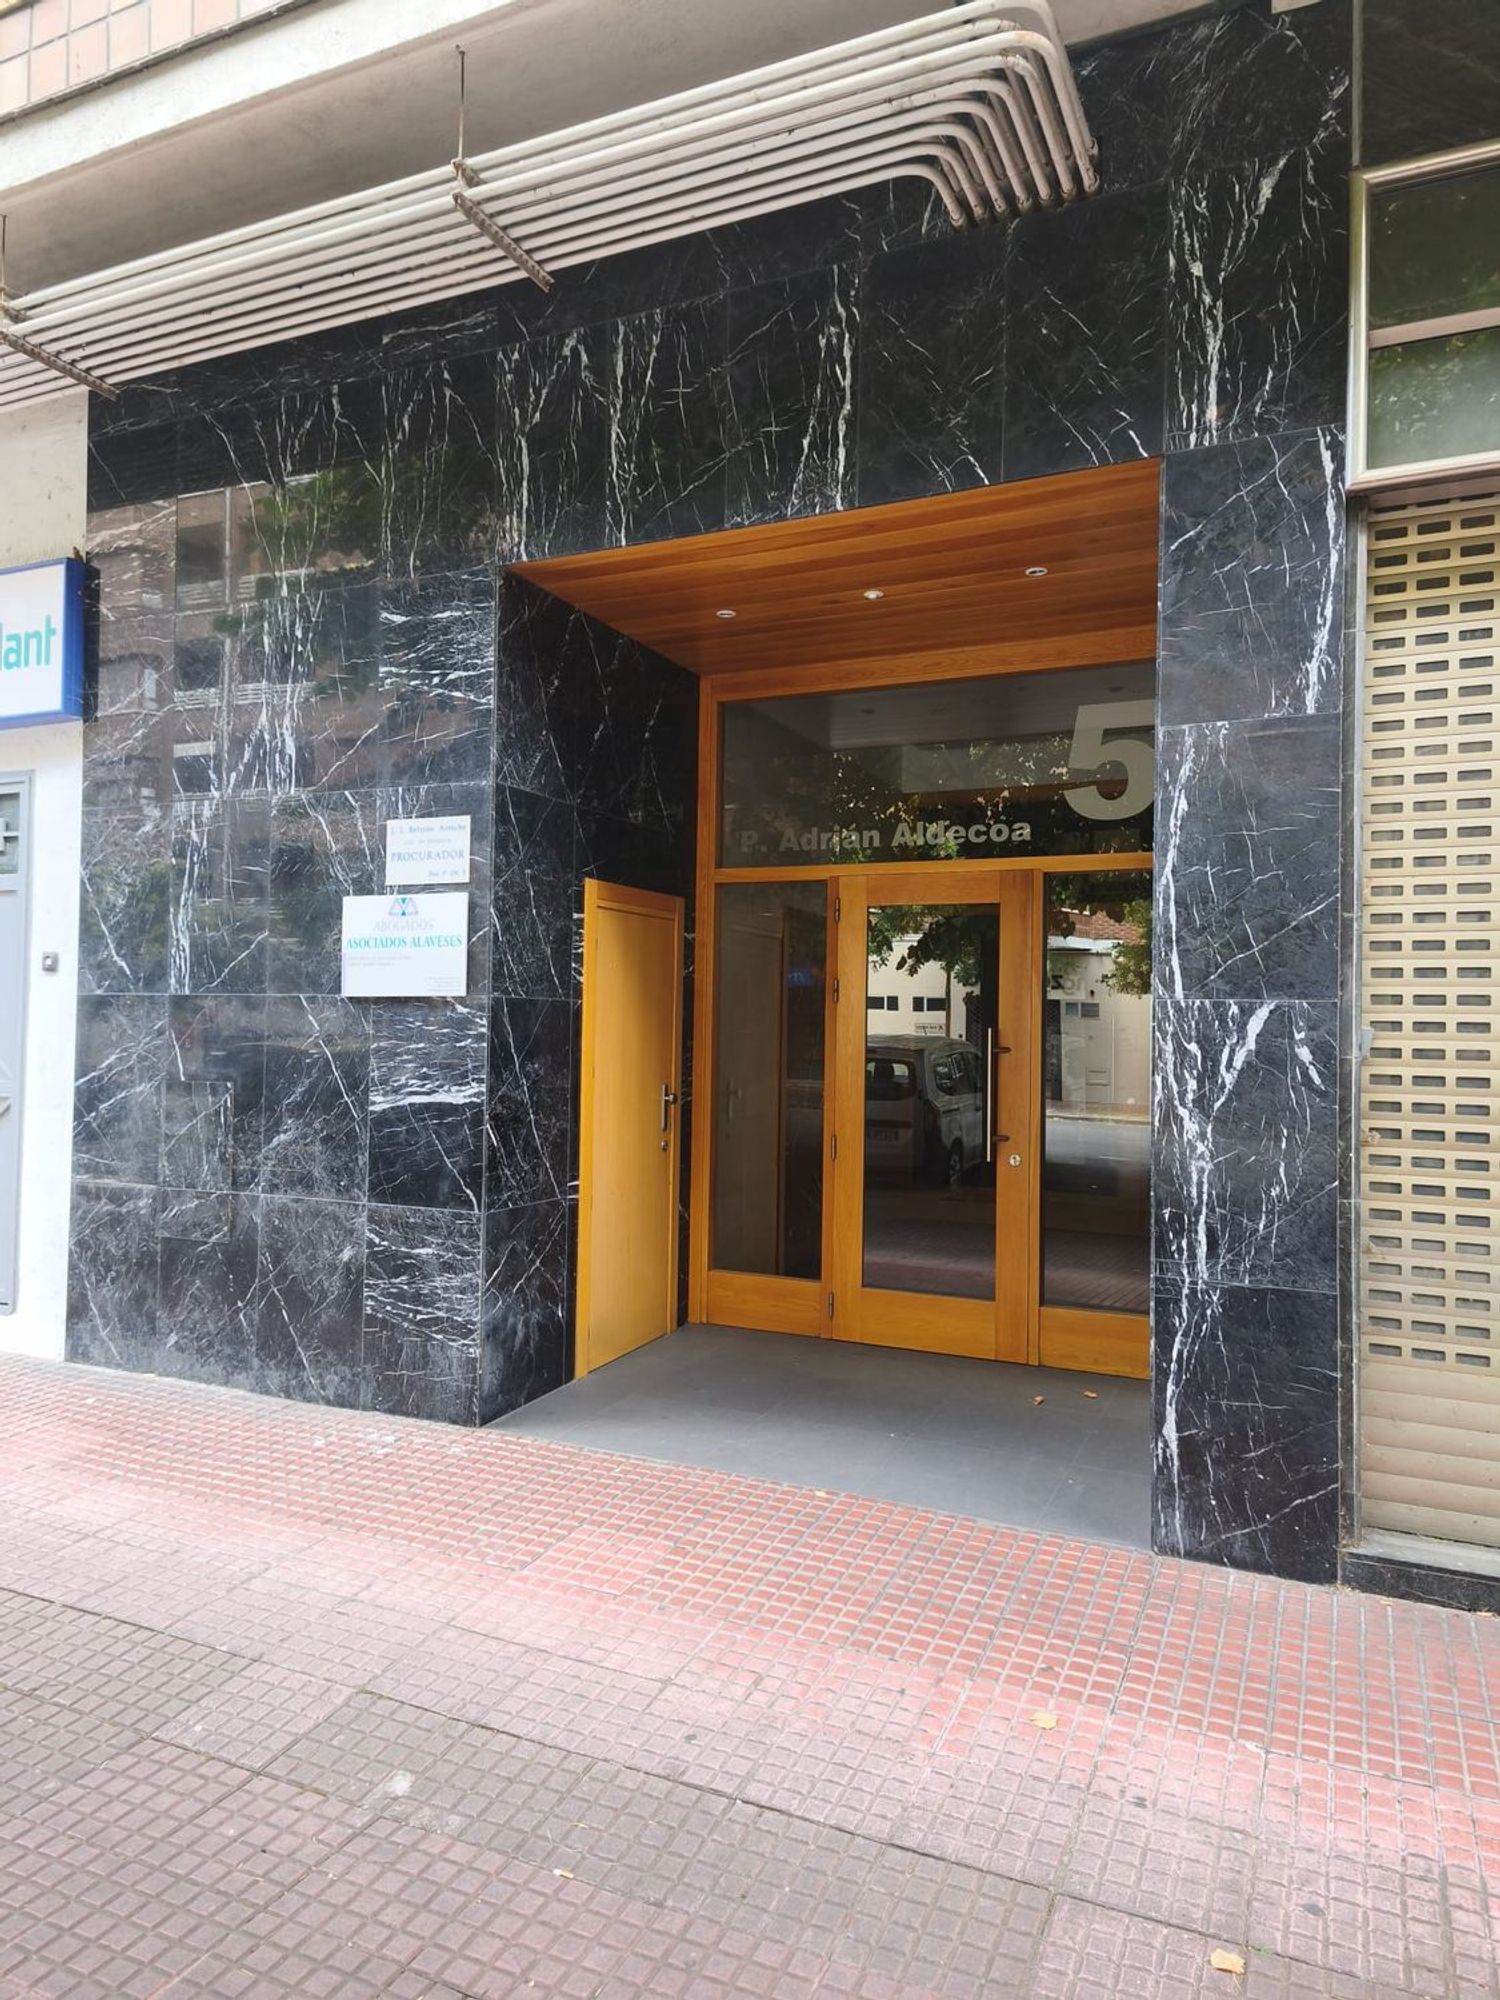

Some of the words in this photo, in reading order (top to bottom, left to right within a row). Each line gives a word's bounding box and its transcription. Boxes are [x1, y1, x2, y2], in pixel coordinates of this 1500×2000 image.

[1063, 699, 1155, 820] 5
[779, 824, 881, 852] Adrián
[891, 820, 1032, 848] Aldecoa
[390, 849, 464, 863] PROCURADOR
[347, 936, 407, 949] ASOCIADOS
[411, 934, 462, 948] ALAVESES
